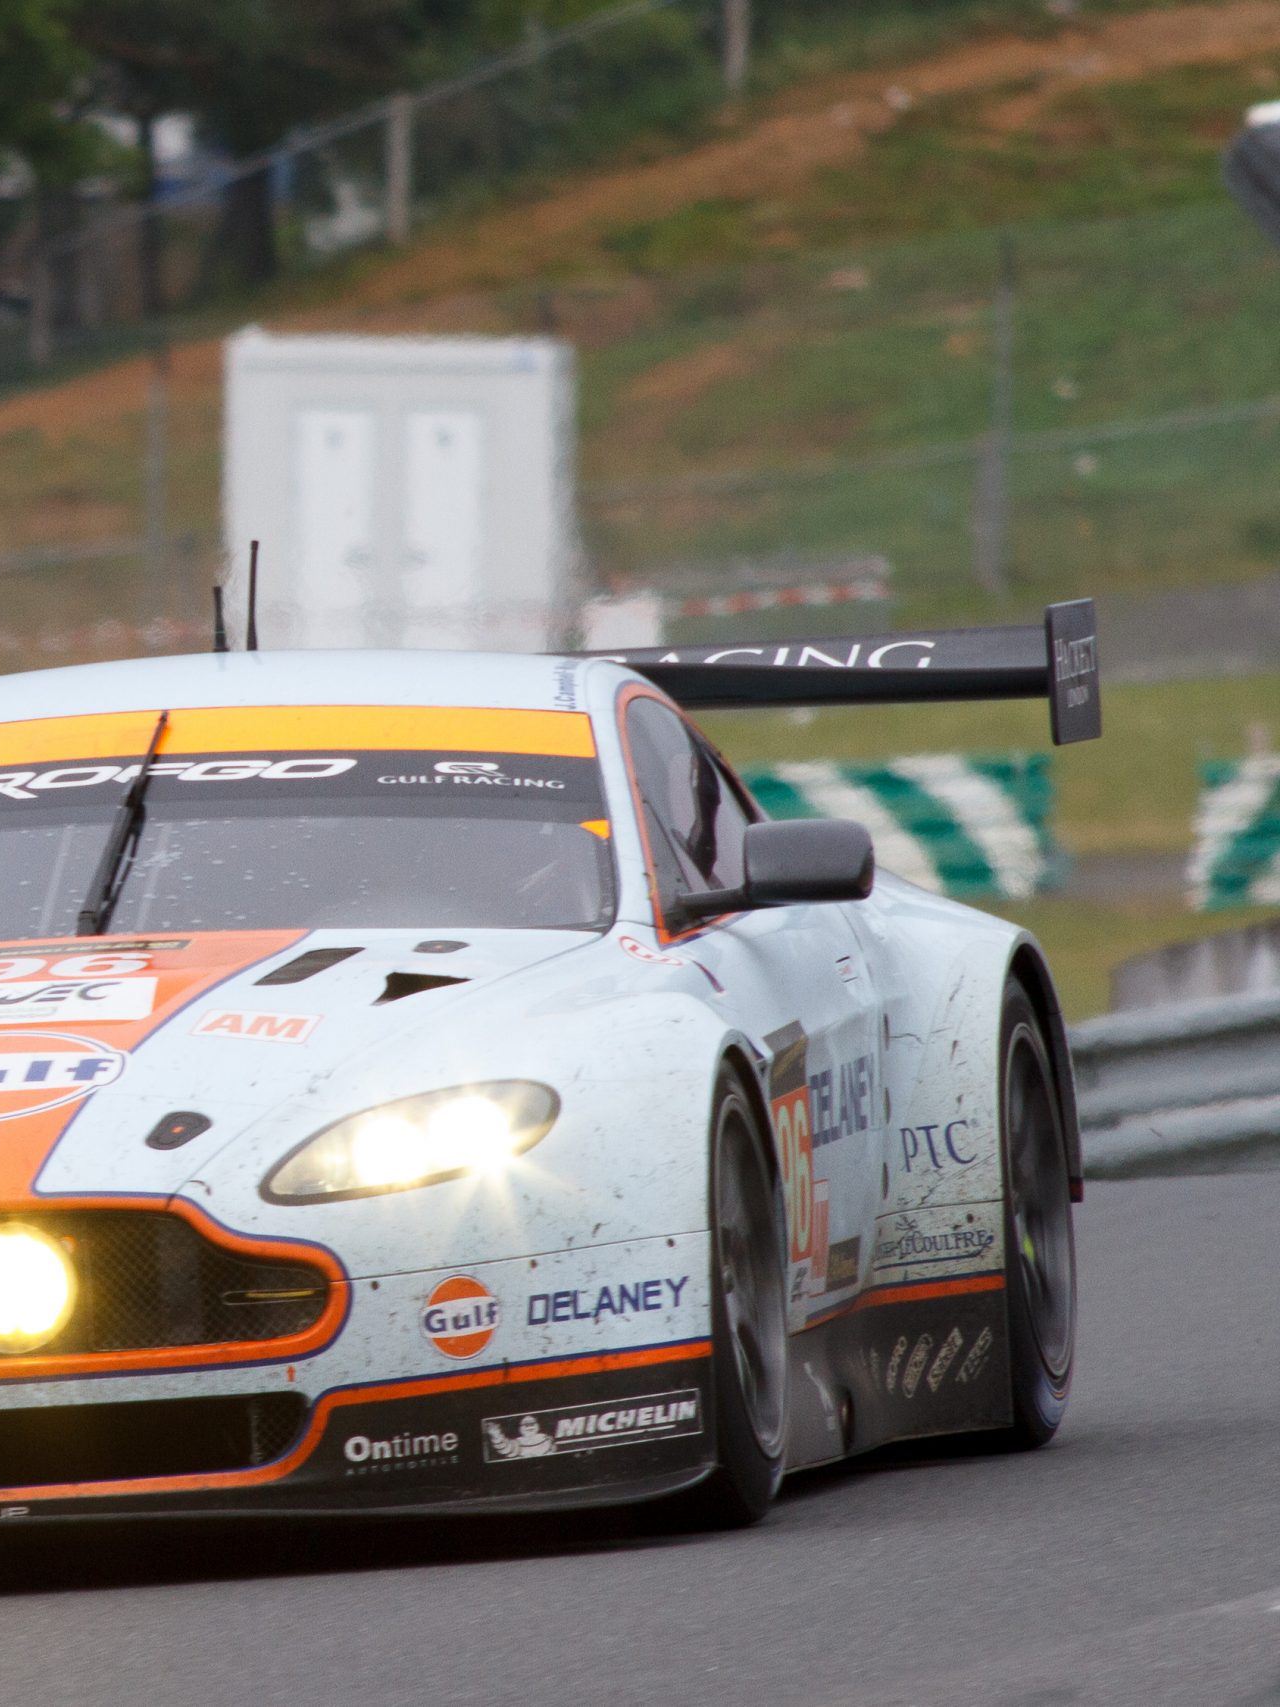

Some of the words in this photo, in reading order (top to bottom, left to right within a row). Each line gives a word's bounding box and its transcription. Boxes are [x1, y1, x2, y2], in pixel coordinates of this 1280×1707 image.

[376, 775, 449, 784] GULF
[453, 776, 566, 789] RACING
[202, 1013, 310, 1039] AM
[809, 1053, 876, 1150] DELANEY
[899, 1119, 978, 1173] PTC
[424, 1301, 500, 1334] Gulf
[527, 1276, 690, 1326] DELANEY
[556, 1400, 697, 1438] MICHELIN
[344, 1432, 459, 1462] Ontime
